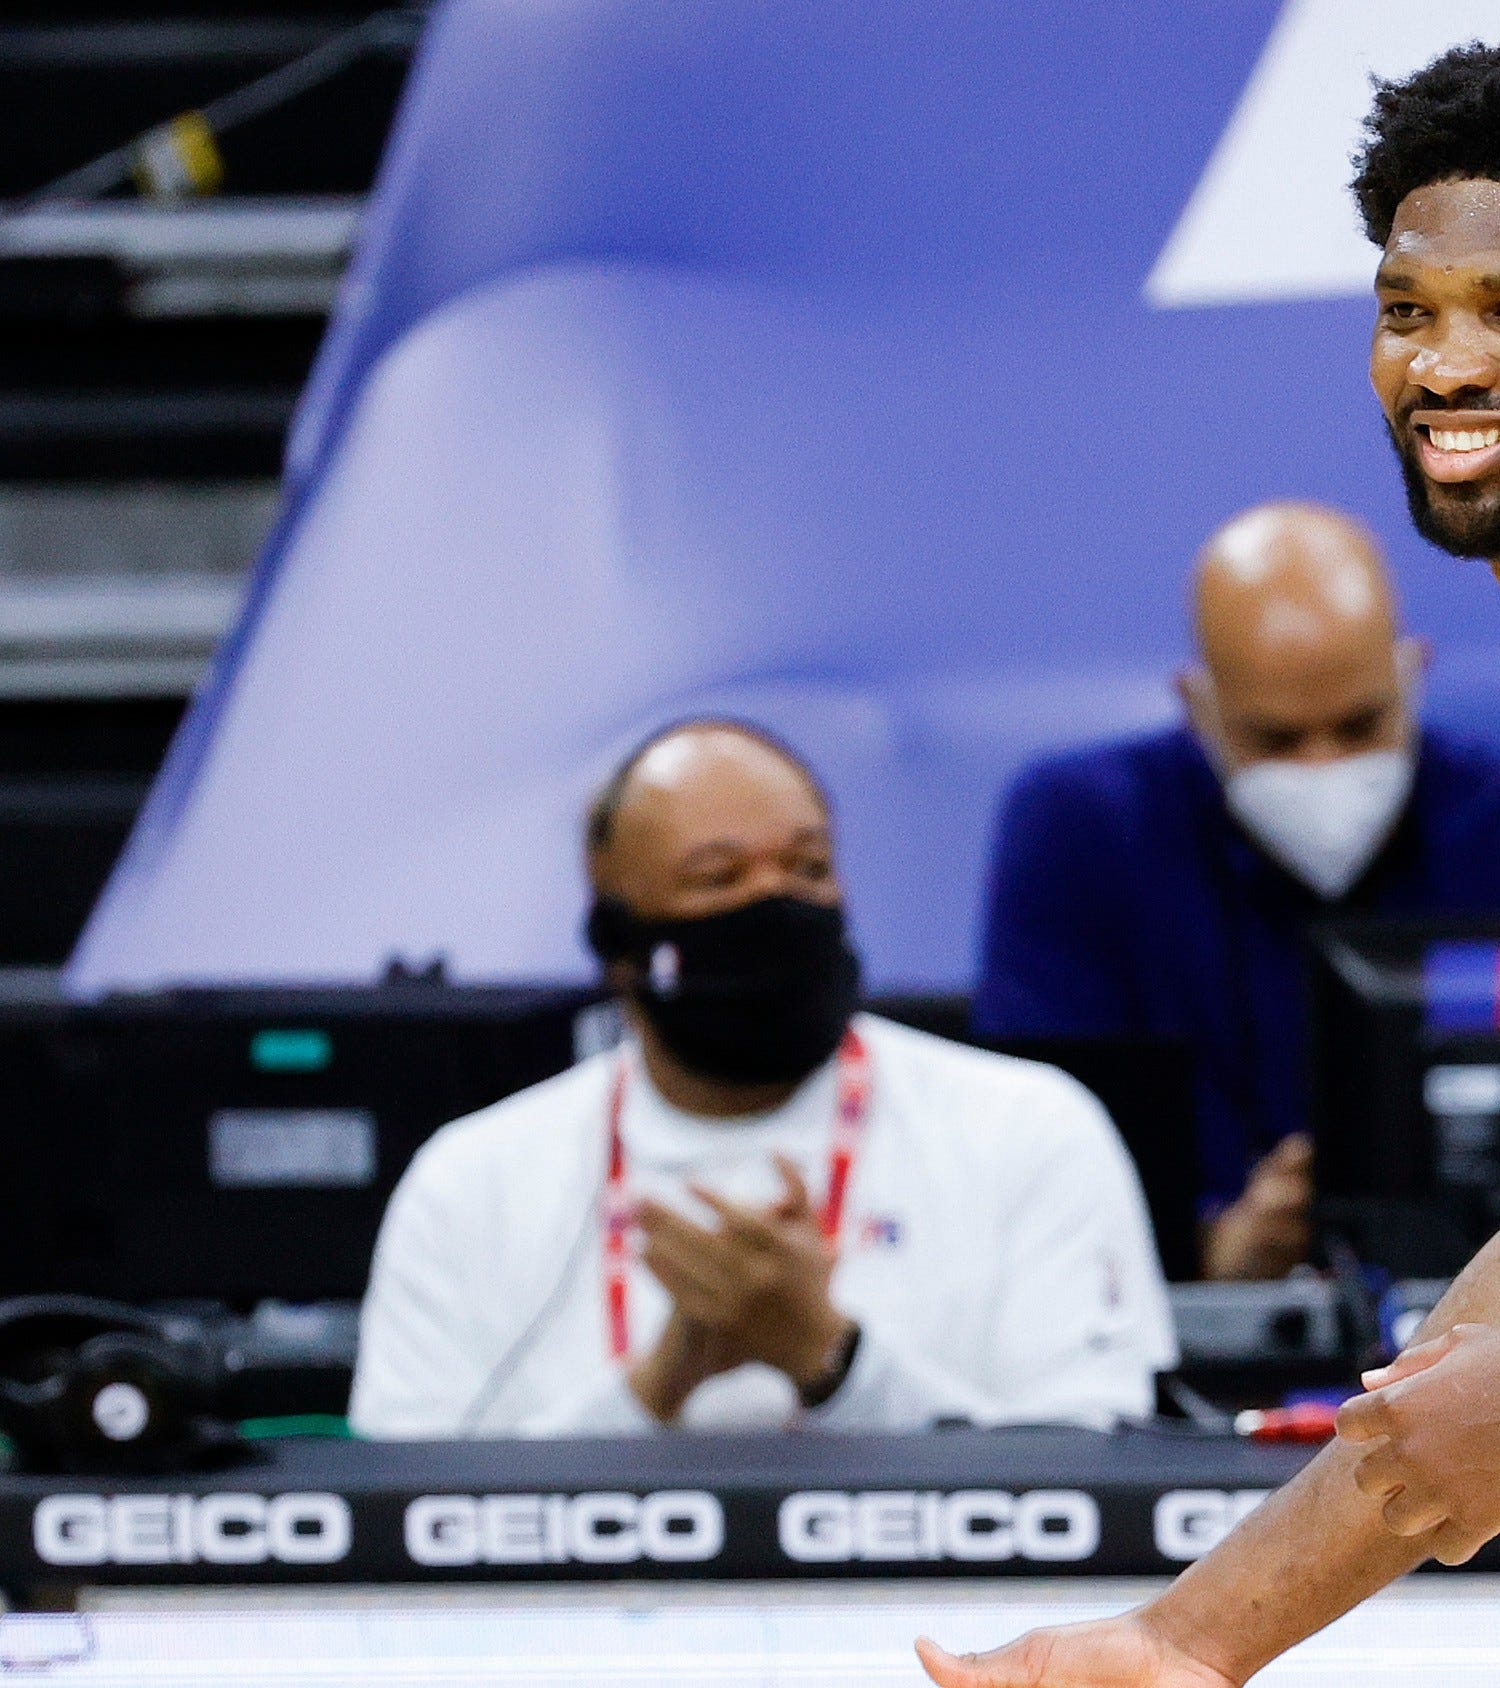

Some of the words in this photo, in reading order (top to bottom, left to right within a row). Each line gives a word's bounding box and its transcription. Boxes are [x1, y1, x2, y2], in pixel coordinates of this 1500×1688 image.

[33, 1493, 352, 1566] GEICO
[404, 1490, 725, 1566] GEICO
[778, 1488, 1100, 1564] GEICO
